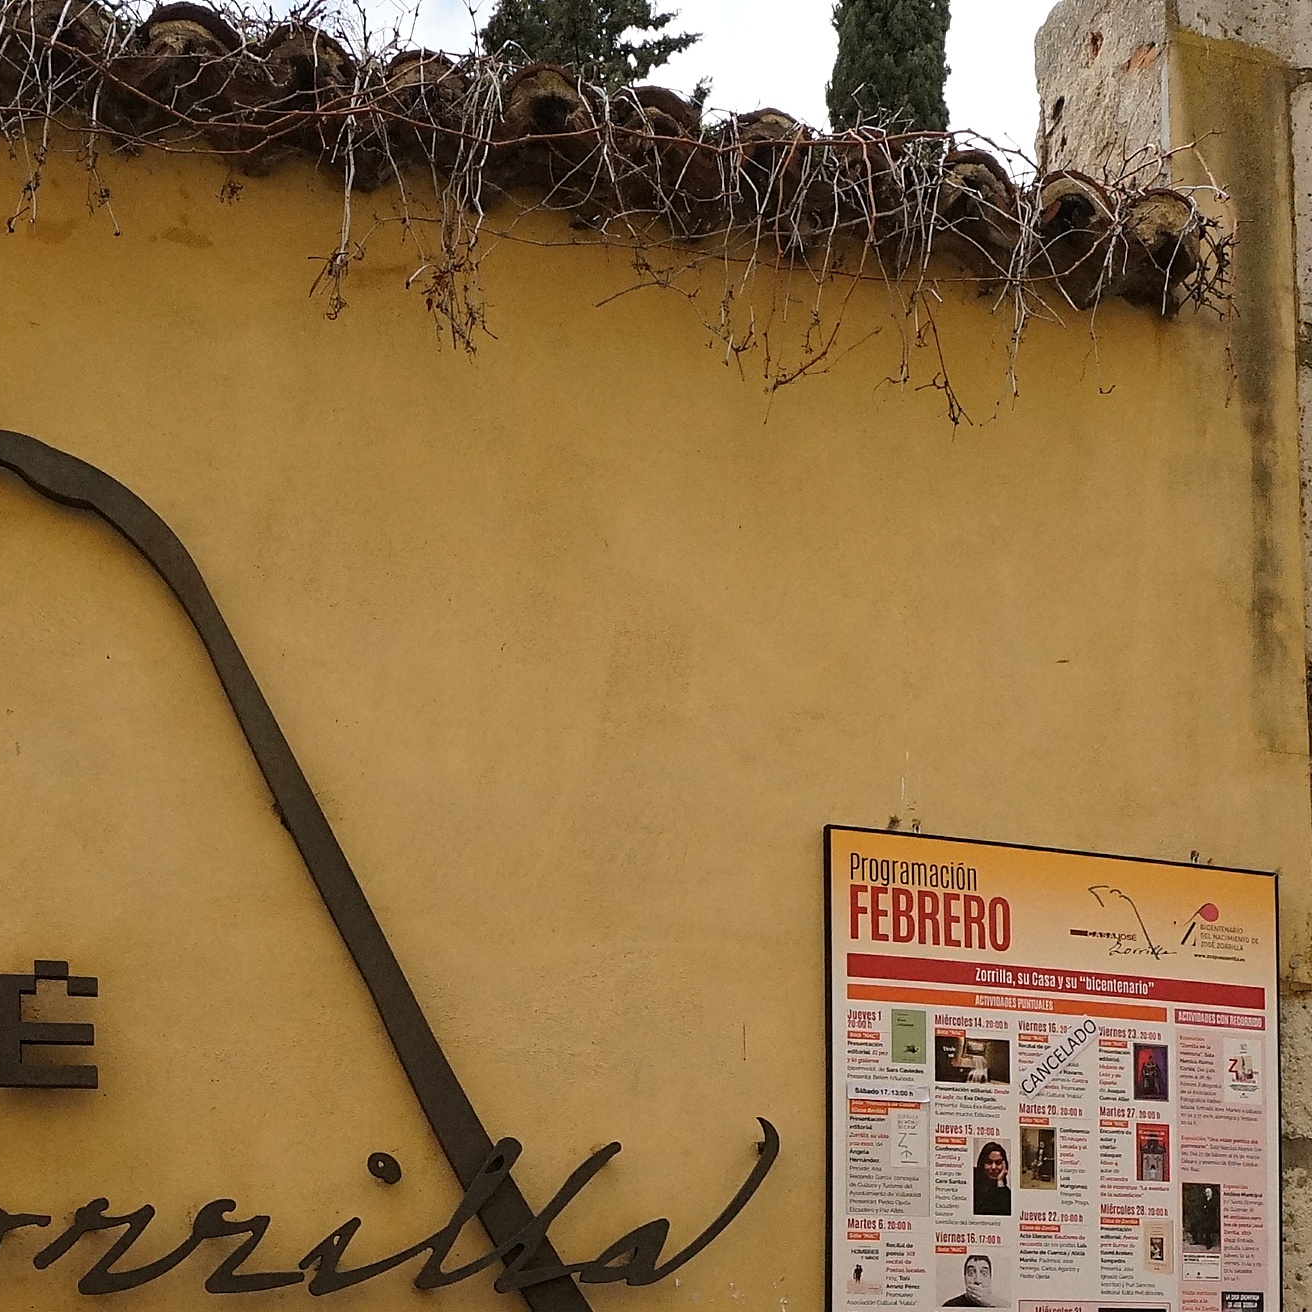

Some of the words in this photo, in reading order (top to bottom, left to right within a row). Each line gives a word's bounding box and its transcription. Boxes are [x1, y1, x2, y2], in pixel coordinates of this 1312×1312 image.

[850, 853, 977, 891] Programación
[850, 884, 1011, 951] FEBRERO
[1200, 924, 1243, 934] BICENTENARIO
[1213, 934, 1249, 943] NACIMIENTO
[1217, 943, 1243, 951] ZORRILLA
[976, 968, 1016, 986] Zorrilla,
[1018, 972, 1029, 985] su
[1032, 972, 1055, 987] Casa
[1058, 976, 1063, 990] y
[1066, 976, 1077, 989] su
[975, 995, 1017, 1008] ACTIVIDADES
[1018, 998, 1053, 1011] PUNTUALES
[847, 1009, 874, 1021] Jueves
[876, 1010, 881, 1021] 1
[935, 1014, 972, 1027] Miércoles
[986, 1020, 1003, 1029] 20:00
[1004, 1020, 1008, 1029] h
[1178, 1011, 1215, 1024] ACTIVIDADES
[1217, 1014, 1228, 1025] CON
[1230, 1016, 1262, 1028] RECORRIDO
[848, 1020, 866, 1029] 20:00
[867, 1020, 872, 1029] h
[1018, 1020, 1047, 1033] Viernes
[1098, 1026, 1126, 1037] Viernes
[1140, 1031, 1157, 1040] 20:00
[1158, 1032, 1161, 1040] h
[847, 1040, 883, 1048] Presentación
[1021, 1019, 1097, 1094] CANCELADO
[855, 1087, 879, 1095] Sábado
[891, 1089, 908, 1097] 13:00
[1019, 1103, 1046, 1115] Martes
[1060, 1107, 1078, 1116] 20:00
[1079, 1108, 1082, 1116] h
[1099, 1106, 1125, 1118] Martes
[1139, 1110, 1156, 1119] 20:00
[1157, 1111, 1160, 1119] h
[935, 1123, 963, 1135] Jueves
[977, 1127, 994, 1136] 20:00
[996, 1128, 1000, 1136] h
[1100, 1204, 1135, 1216] Miércoles
[1148, 1207, 1164, 1216] 20:00
[1019, 1211, 1046, 1222] Jueves
[1061, 1214, 1078, 1222] 20:00
[1079, 1214, 1083, 1223] h
[847, 1218, 876, 1230] Martes
[888, 1220, 906, 1230] 20:00
[907, 1221, 911, 1230] h
[935, 1232, 965, 1244] Viernes
[979, 1235, 996, 1244] 17:00
